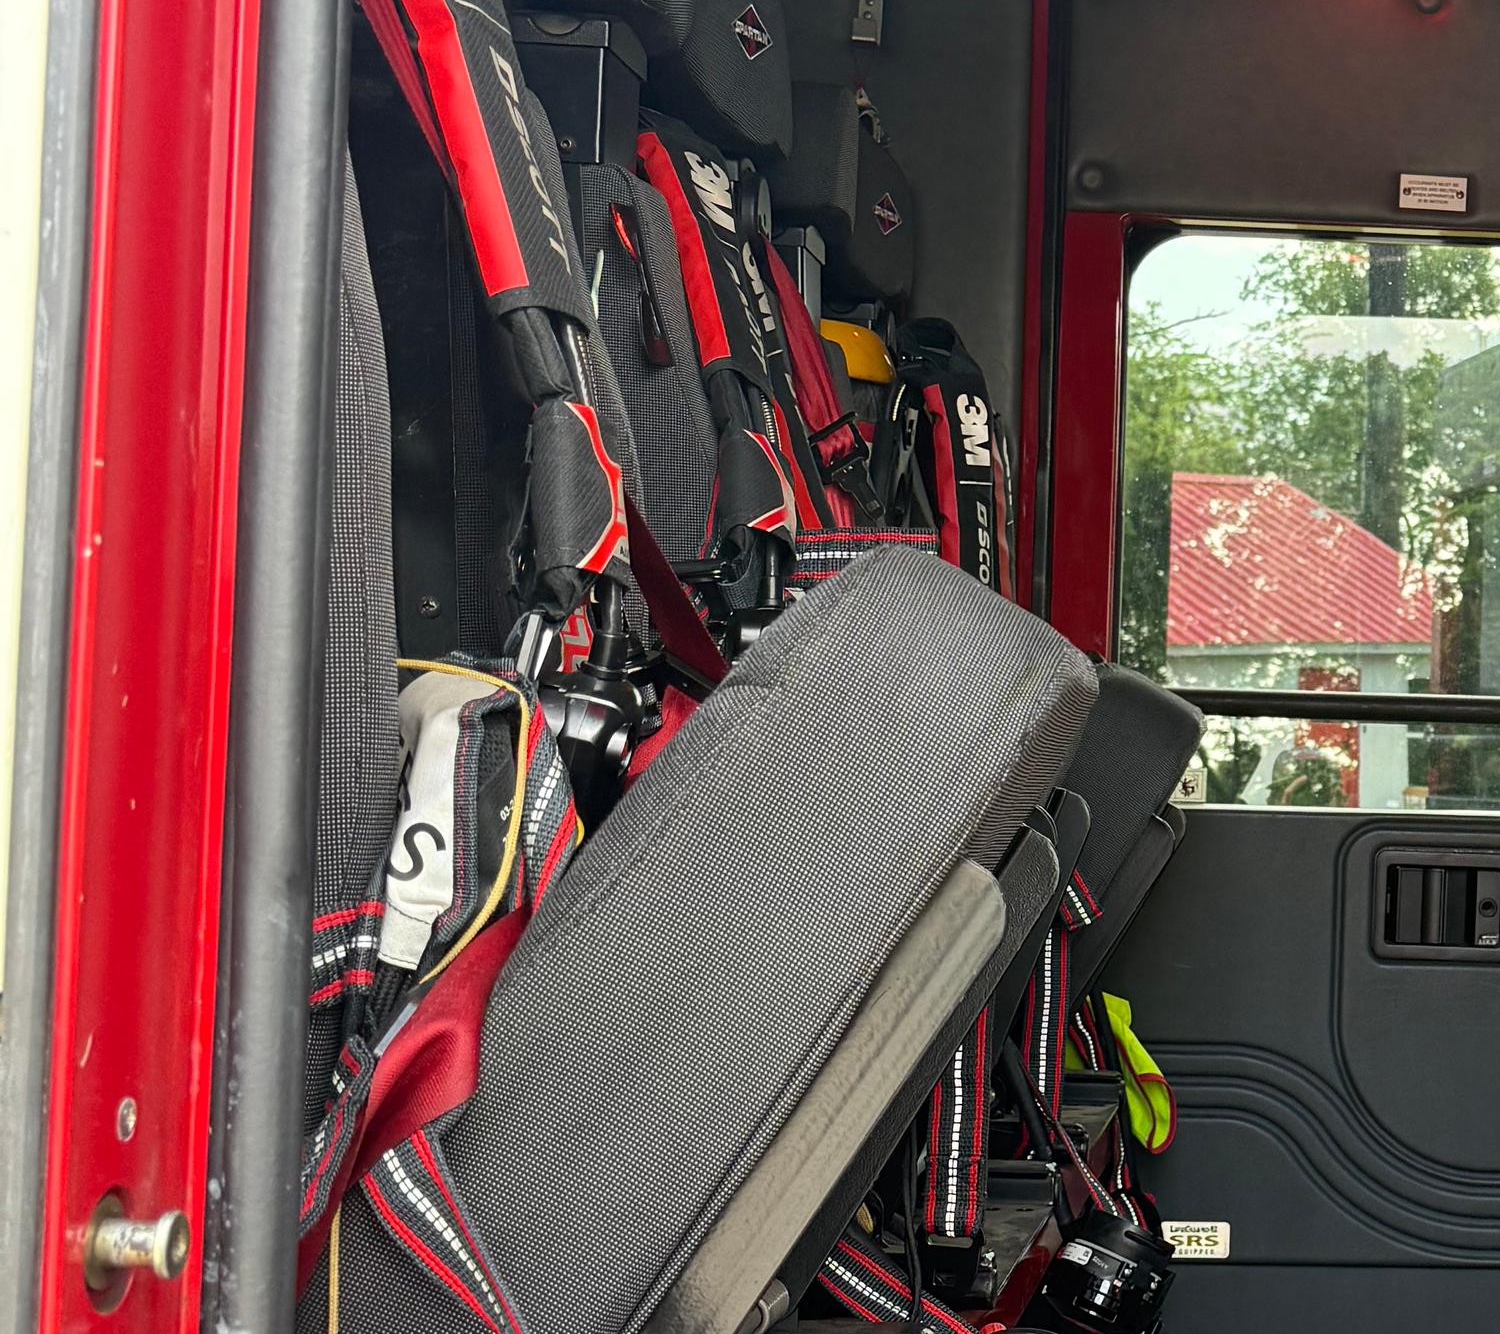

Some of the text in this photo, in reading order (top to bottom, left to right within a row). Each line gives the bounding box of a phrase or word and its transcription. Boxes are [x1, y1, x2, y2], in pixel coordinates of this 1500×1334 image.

[684, 150, 737, 234] 3M
[957, 393, 992, 590] 3M SCO
[1169, 1235, 1219, 1247] SRS
